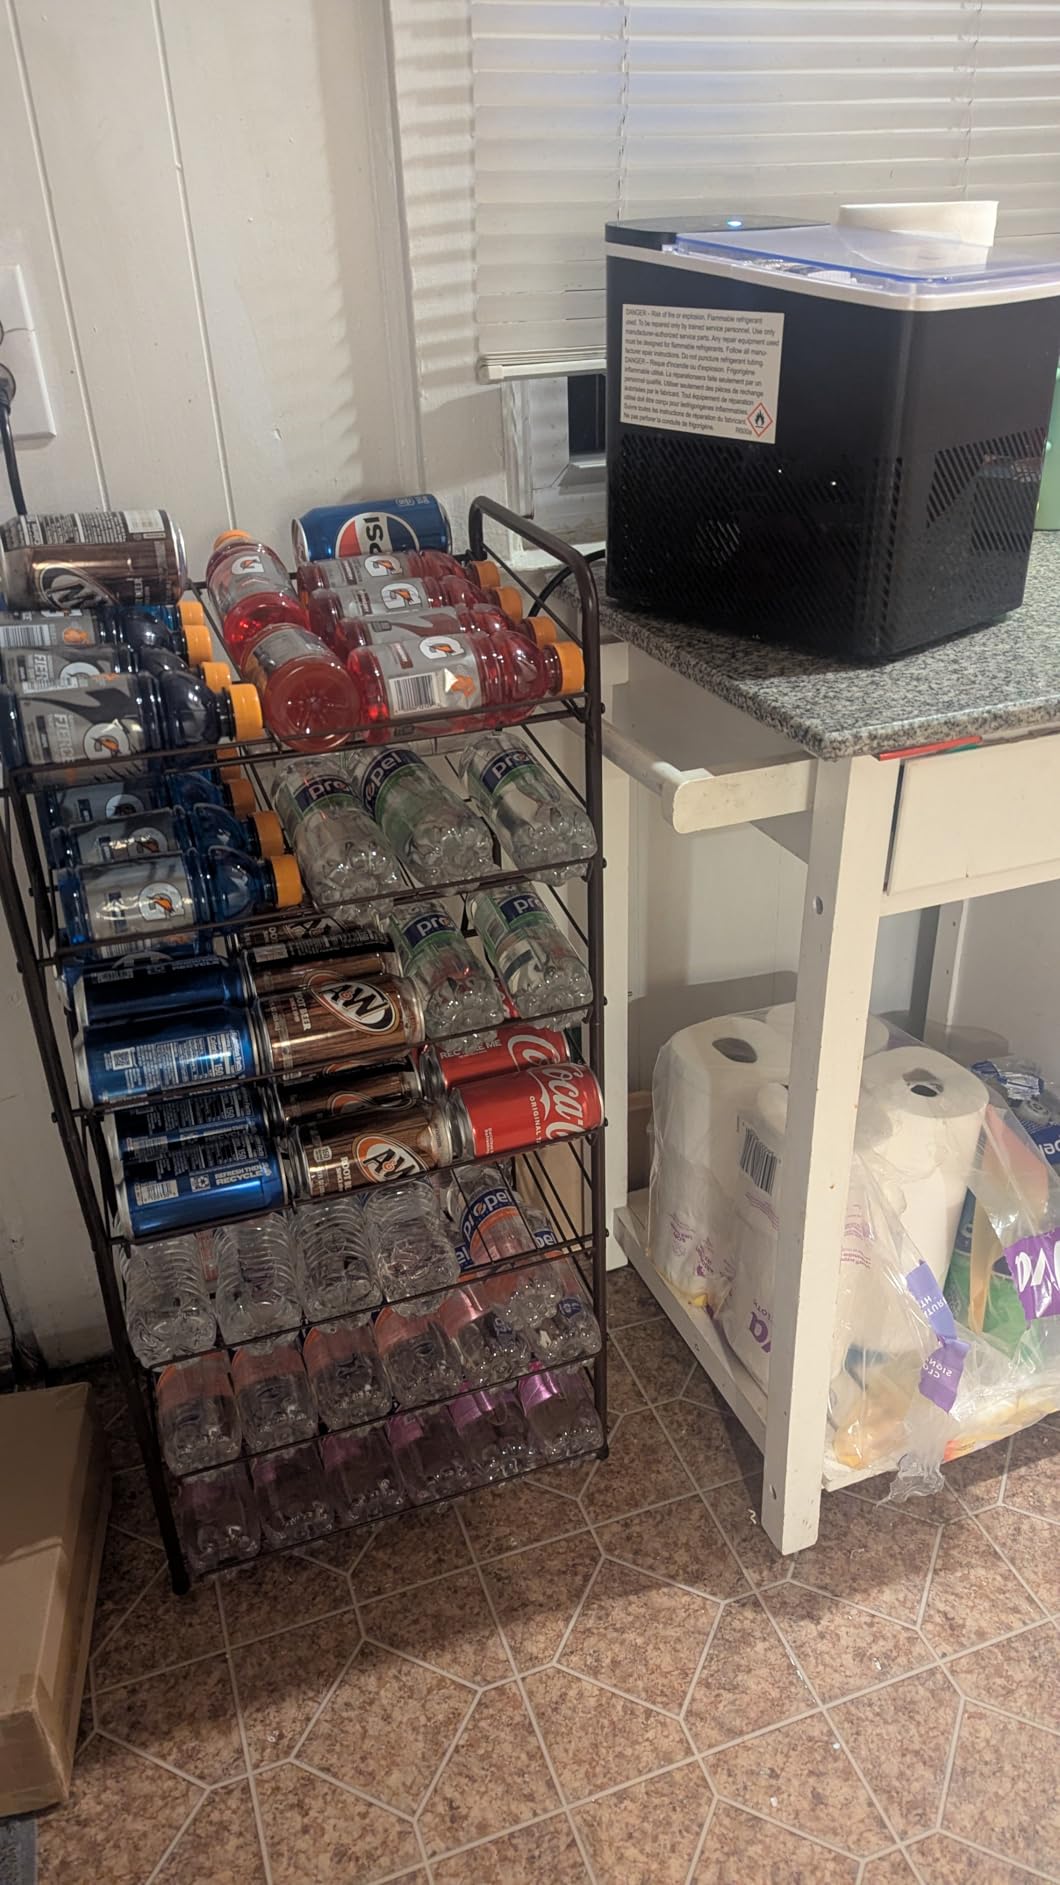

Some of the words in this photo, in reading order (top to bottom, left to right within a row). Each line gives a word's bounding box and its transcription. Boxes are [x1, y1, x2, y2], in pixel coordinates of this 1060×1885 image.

[363, 516, 383, 555] PSI
[364, 752, 404, 801] opel
[491, 750, 531, 780] pro
[308, 779, 350, 801] pro
[416, 915, 457, 938] pro
[299, 1008, 312, 1031] BEER
[486, 1039, 502, 1049] ME
[529, 1095, 543, 1136] ORIGINAL
[215, 1171, 262, 1186] RECYCLE
[340, 1156, 352, 1180] ROOT
